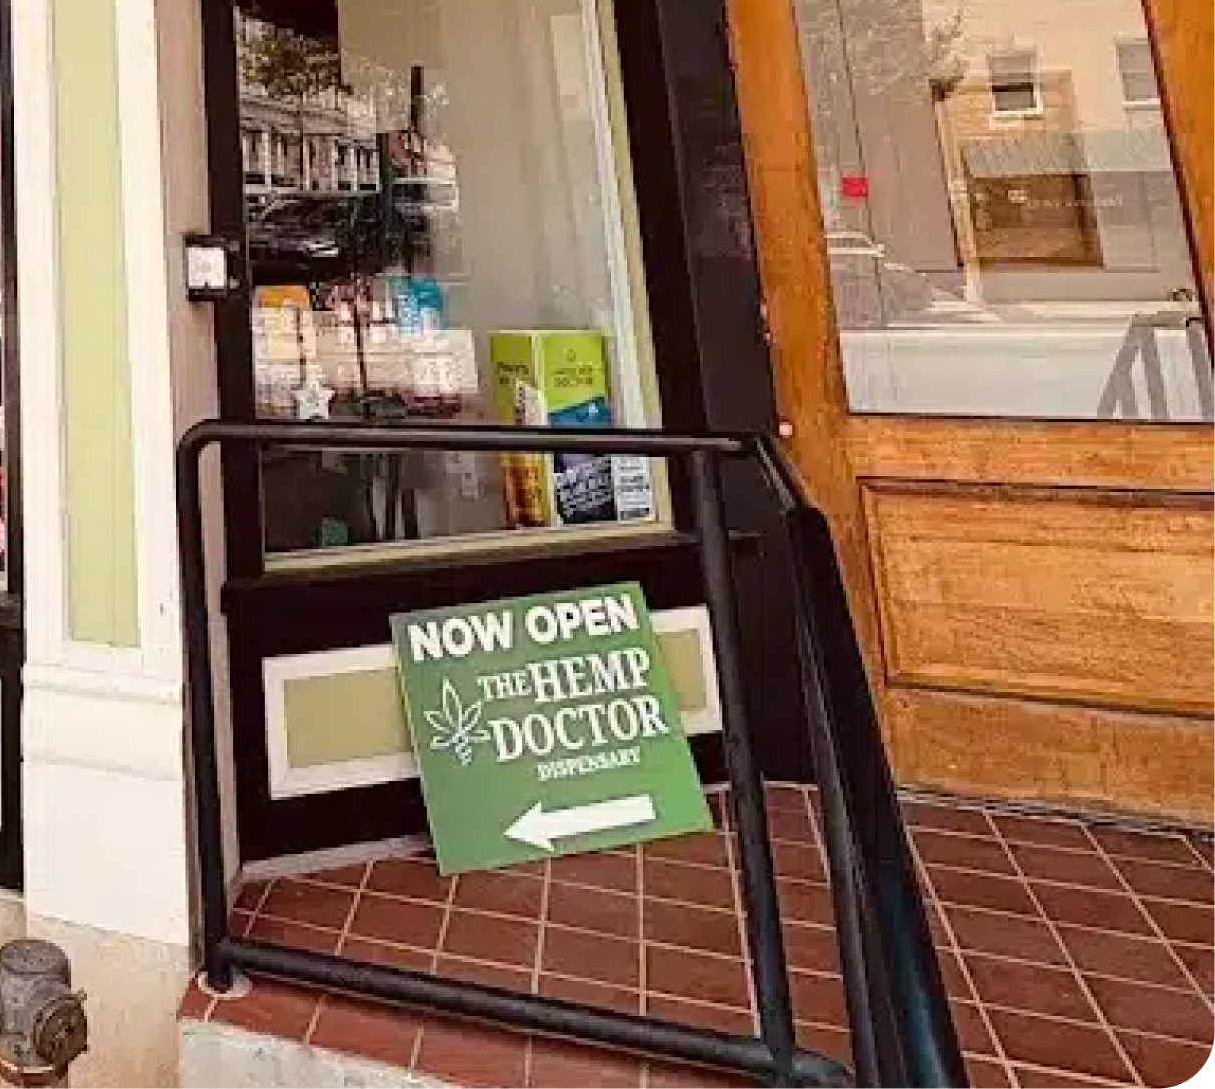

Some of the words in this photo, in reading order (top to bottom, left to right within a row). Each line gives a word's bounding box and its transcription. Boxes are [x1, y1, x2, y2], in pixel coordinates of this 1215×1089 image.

[408, 610, 514, 662] NOW
[525, 593, 640, 644] OPEN
[477, 669, 532, 701] THE
[528, 647, 651, 703] HEMP
[487, 695, 670, 762] DOCTOR
